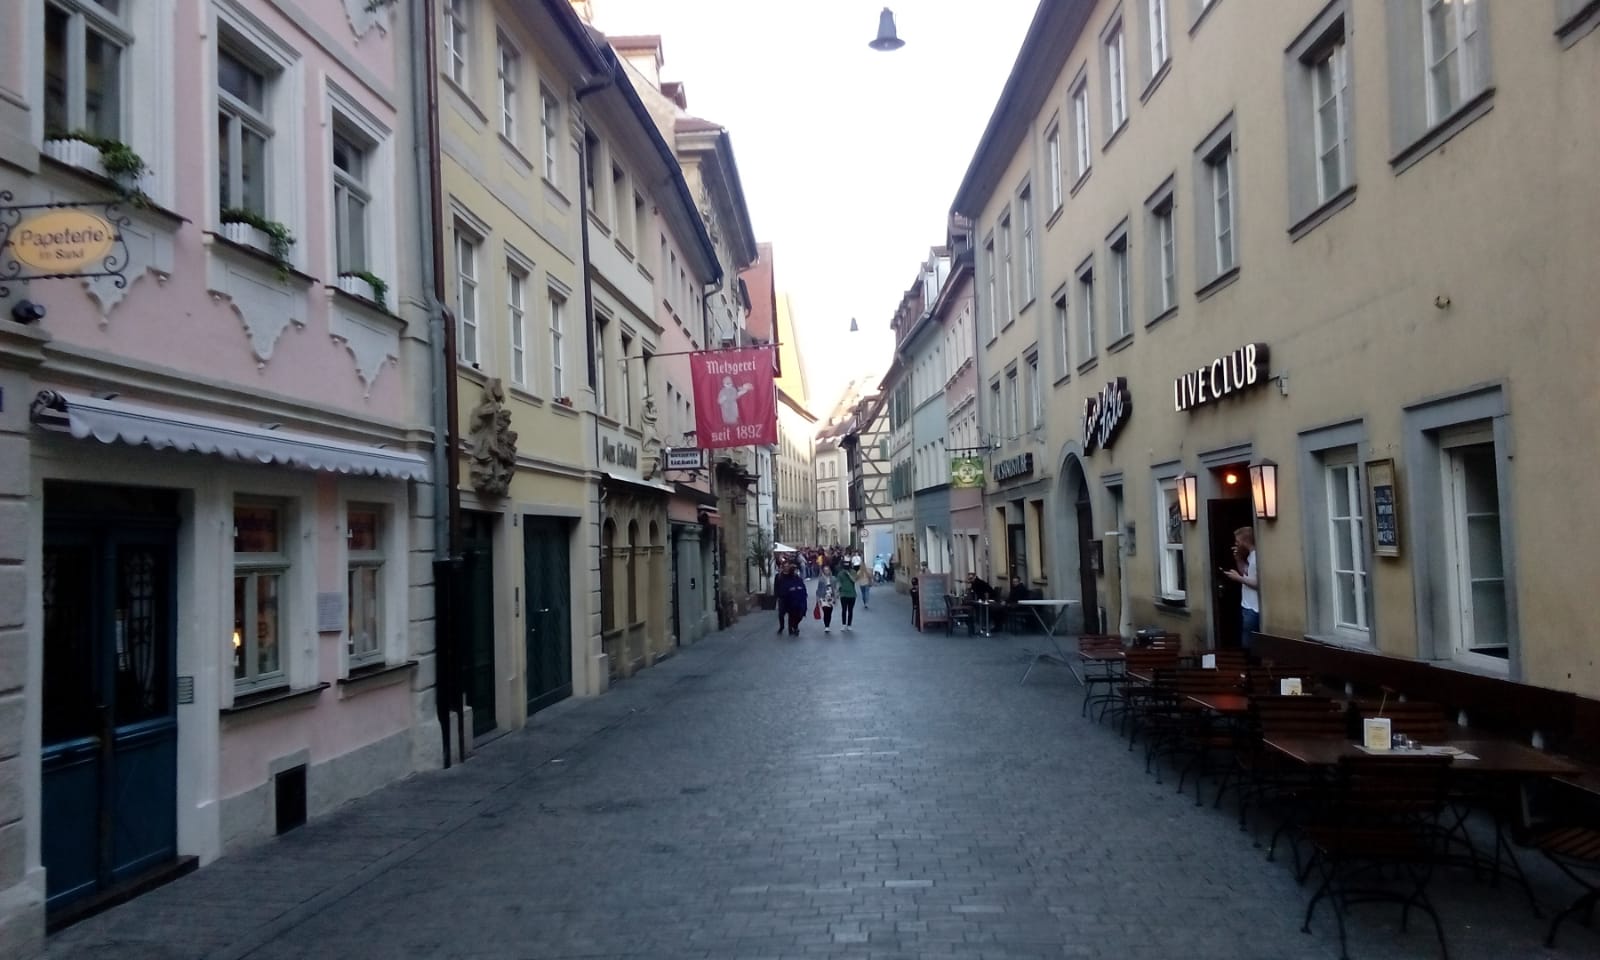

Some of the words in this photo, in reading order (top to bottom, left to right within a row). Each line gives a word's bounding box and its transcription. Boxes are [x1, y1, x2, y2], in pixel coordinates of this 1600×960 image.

[20, 227, 104, 247] Papeterie
[706, 357, 757, 374] Metzgerei
[1174, 366, 1207, 412] LIVE
[1210, 343, 1258, 399] CLUB
[711, 428, 730, 441] seit
[736, 424, 763, 440] 1892
